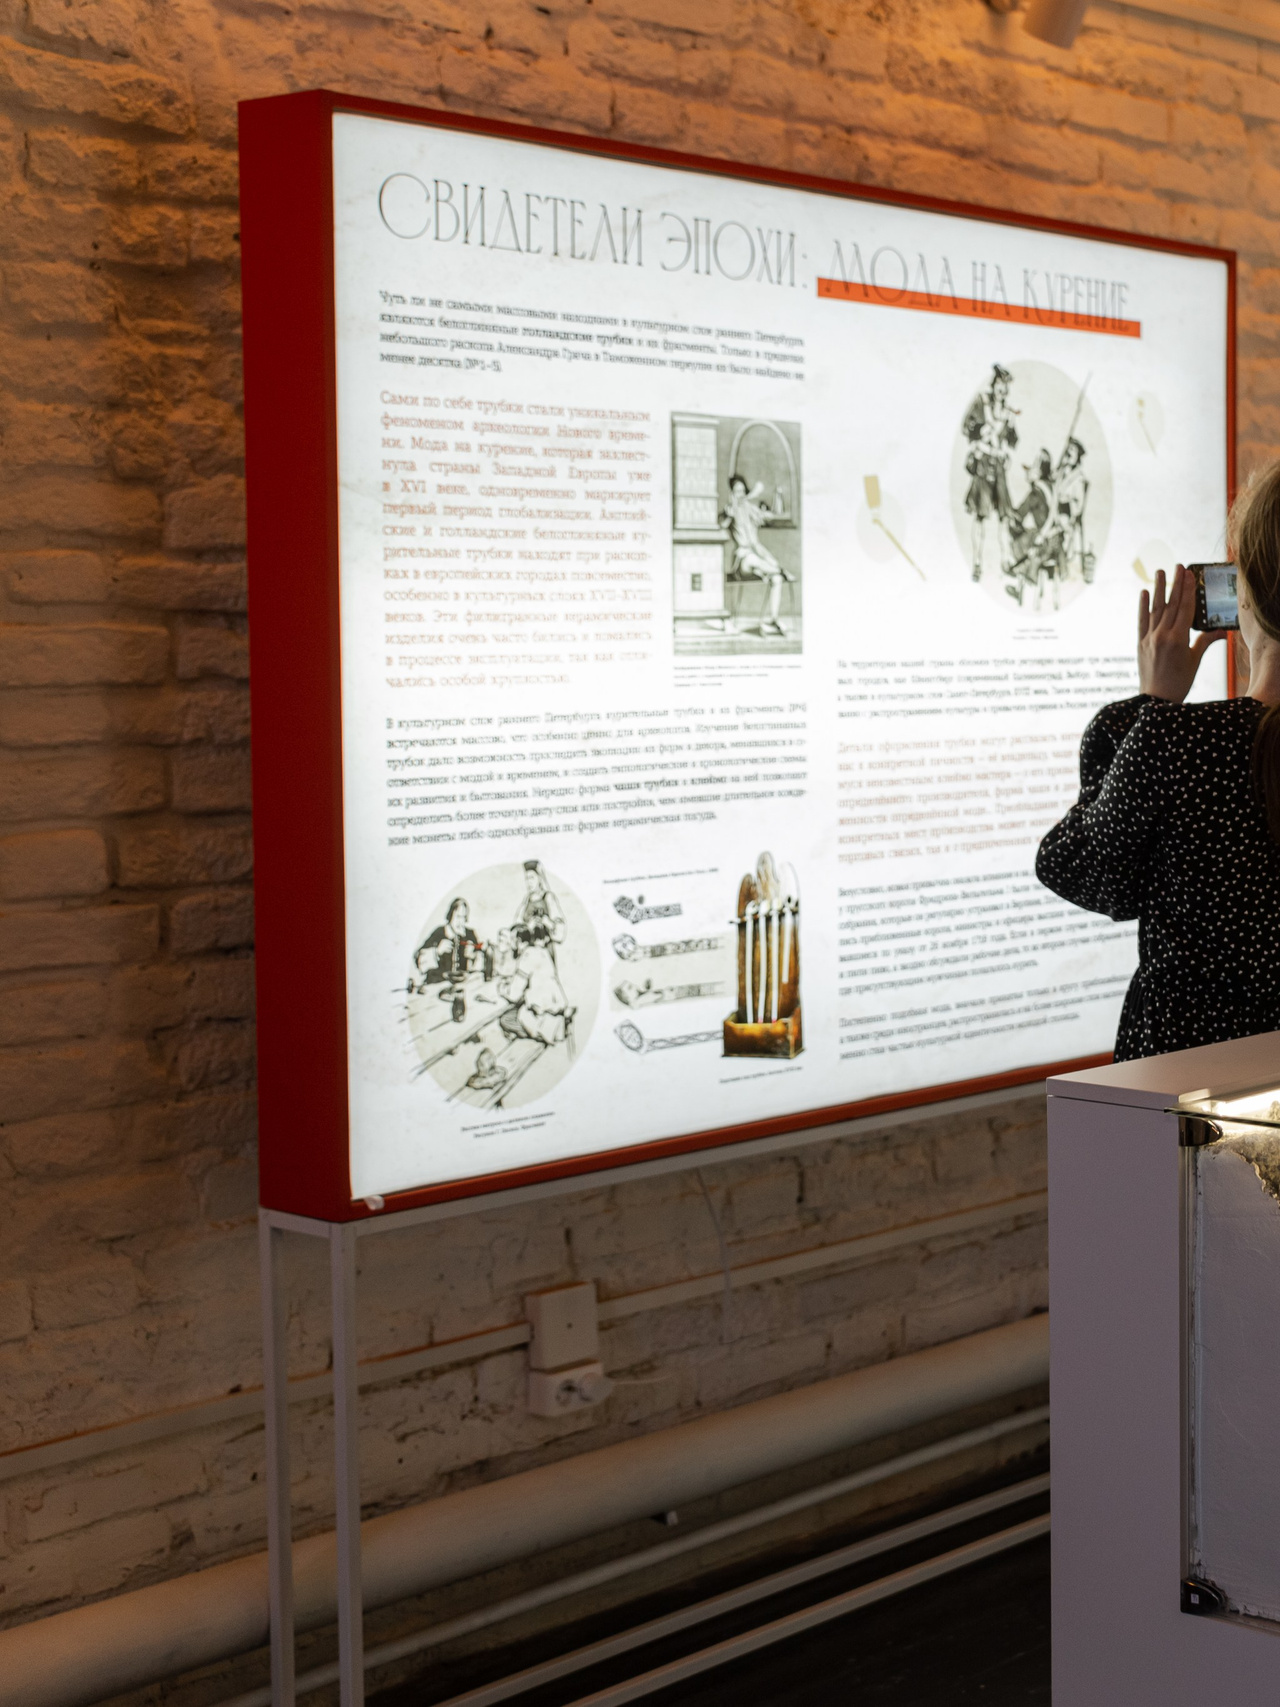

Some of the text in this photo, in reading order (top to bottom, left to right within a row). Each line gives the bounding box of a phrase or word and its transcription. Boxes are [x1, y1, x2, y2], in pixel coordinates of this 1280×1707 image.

[378, 173, 1131, 332] СВИДЕТЕЛИ ЭПОХИ: МОДА НА КУРЕНИЕ
[380, 390, 418, 405] Сами
[443, 395, 472, 409] себе
[477, 398, 523, 415] трубки
[526, 403, 564, 415] стали
[568, 406, 650, 421] уникальным
[380, 412, 650, 444] феноменом археологии Нового време-
[381, 438, 404, 448] ни.
[410, 436, 448, 451] Мода
[477, 443, 537, 458] курение,
[542, 446, 592, 462] которая
[599, 449, 650, 461] захлест-
[382, 459, 650, 485] нула страны Западной Европы уже
[400, 479, 426, 493] XVI
[436, 483, 470, 496] веке,
[478, 485, 575, 501] одновременно
[584, 489, 650, 505] маркирует
[382, 501, 650, 523] первый период глобализации. Англий-
[382, 525, 416, 535] ские
[439, 526, 526, 538] голландские
[532, 525, 625, 541] белоглиняные
[632, 531, 650, 545] ку-
[383, 545, 650, 565] рительные трубки находят при раскоп-
